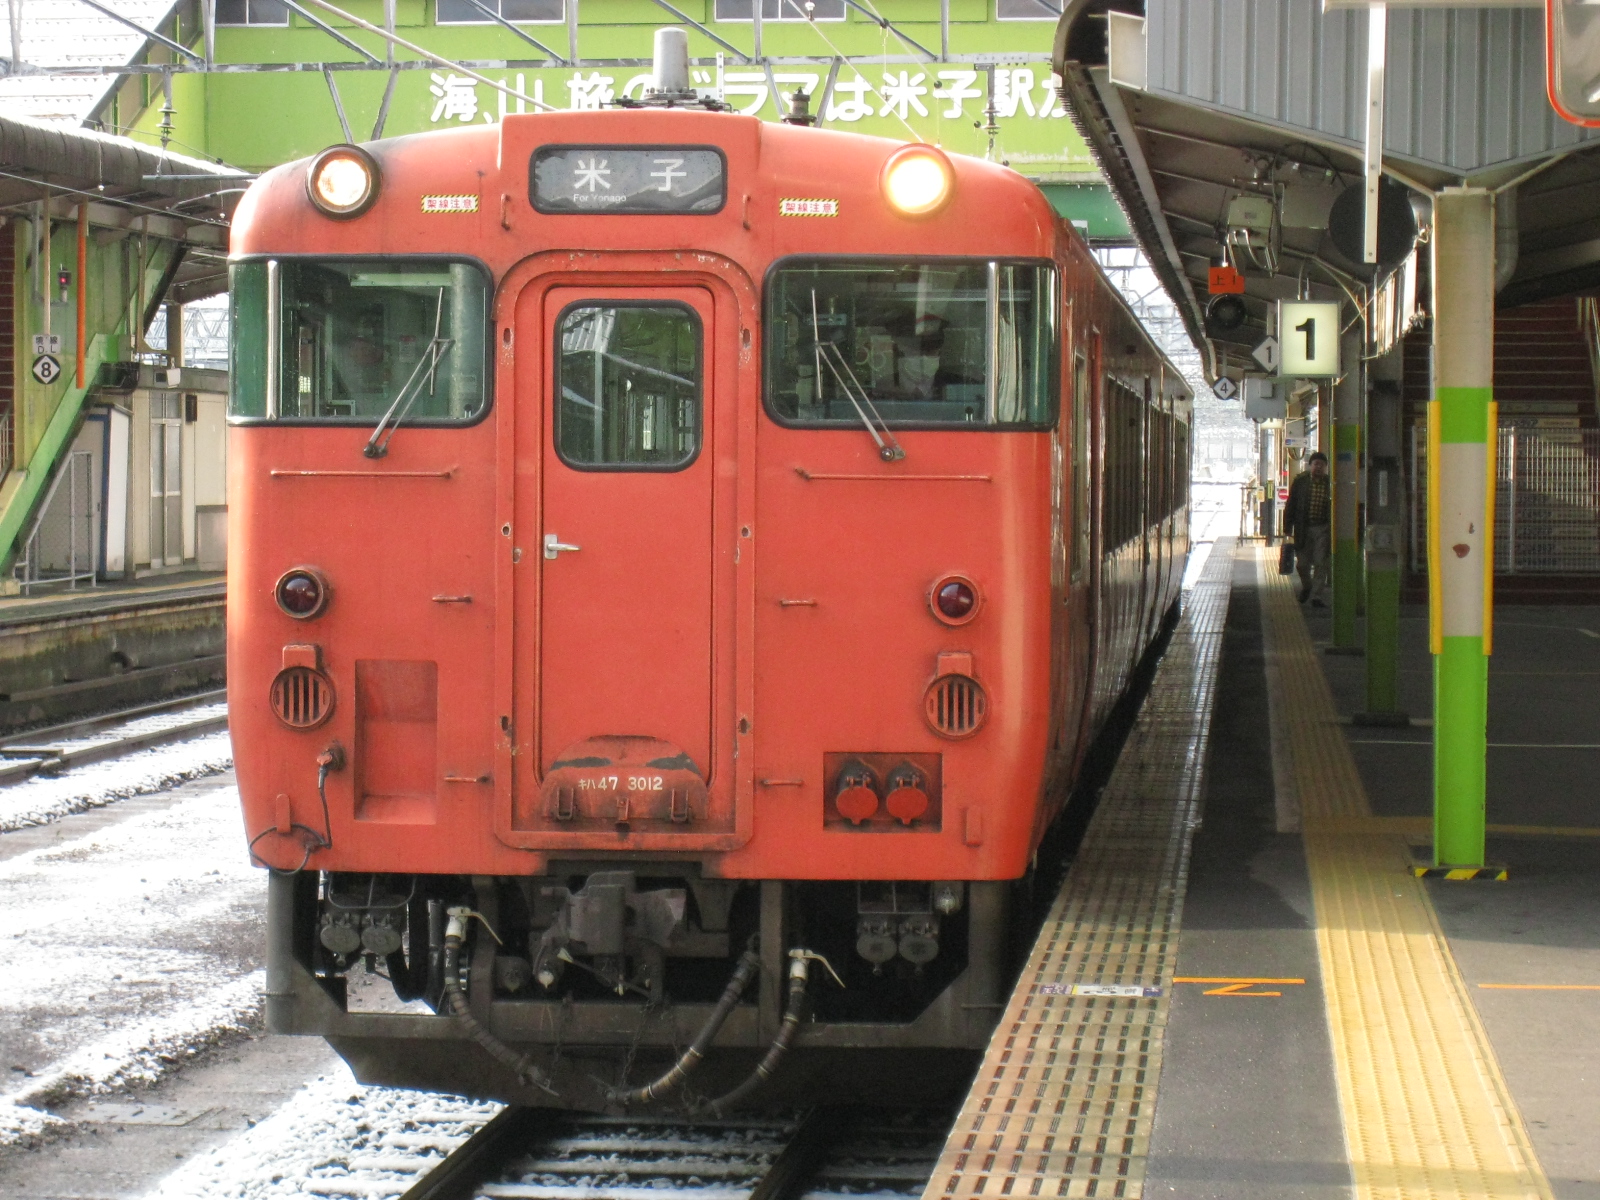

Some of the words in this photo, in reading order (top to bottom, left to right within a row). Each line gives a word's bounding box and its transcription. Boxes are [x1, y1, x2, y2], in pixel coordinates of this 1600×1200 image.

[574, 158, 687, 192] 米子
[573, 194, 589, 202] For
[593, 194, 627, 204] Yonago
[1295, 317, 1316, 361] 1
[1266, 346, 1272, 363] 1
[41, 361, 52, 378] 8
[1220, 382, 1229, 394] 4
[628, 777, 663, 791] 3012
